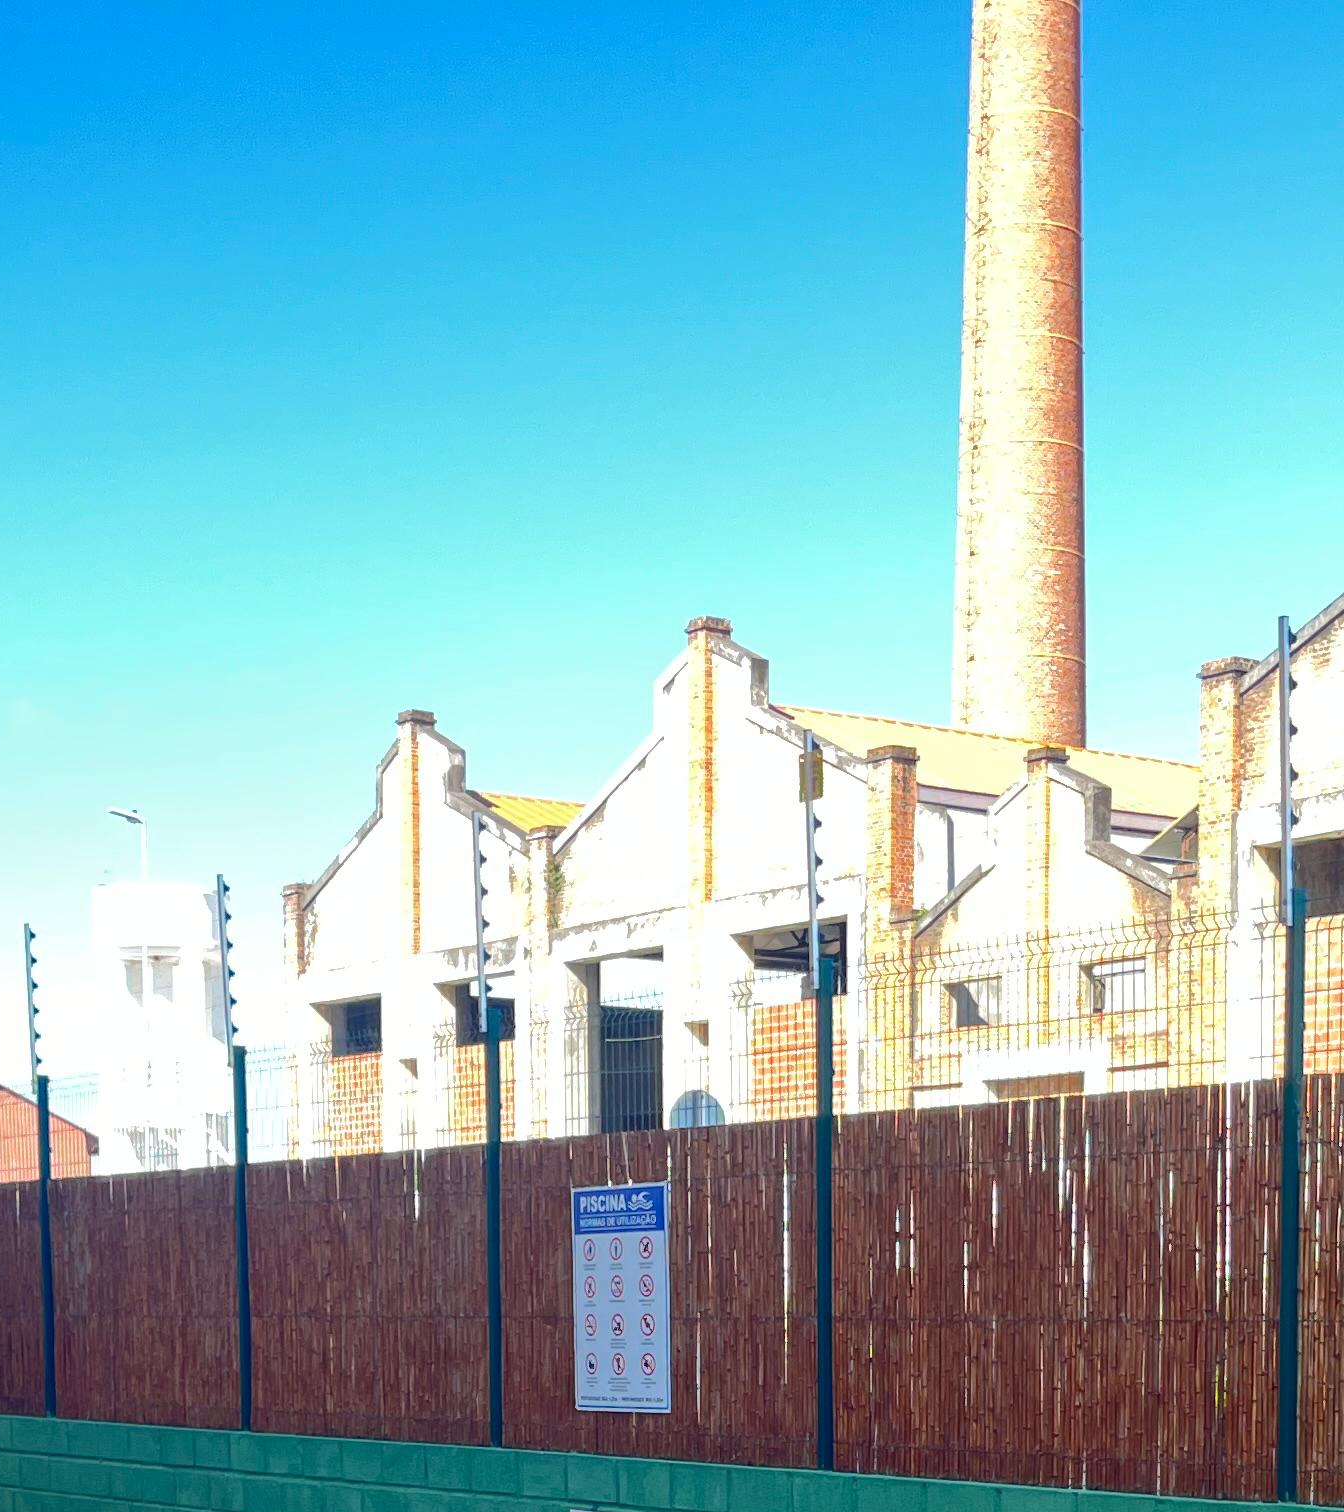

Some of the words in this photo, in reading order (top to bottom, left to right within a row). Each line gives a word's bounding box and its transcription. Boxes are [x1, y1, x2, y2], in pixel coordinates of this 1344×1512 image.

[580, 1194, 626, 1213] PISCINA
[580, 1217, 606, 1228] NORMAS
[607, 1217, 616, 1226] DE
[617, 1214, 656, 1226] UTILIZAÇÃO
